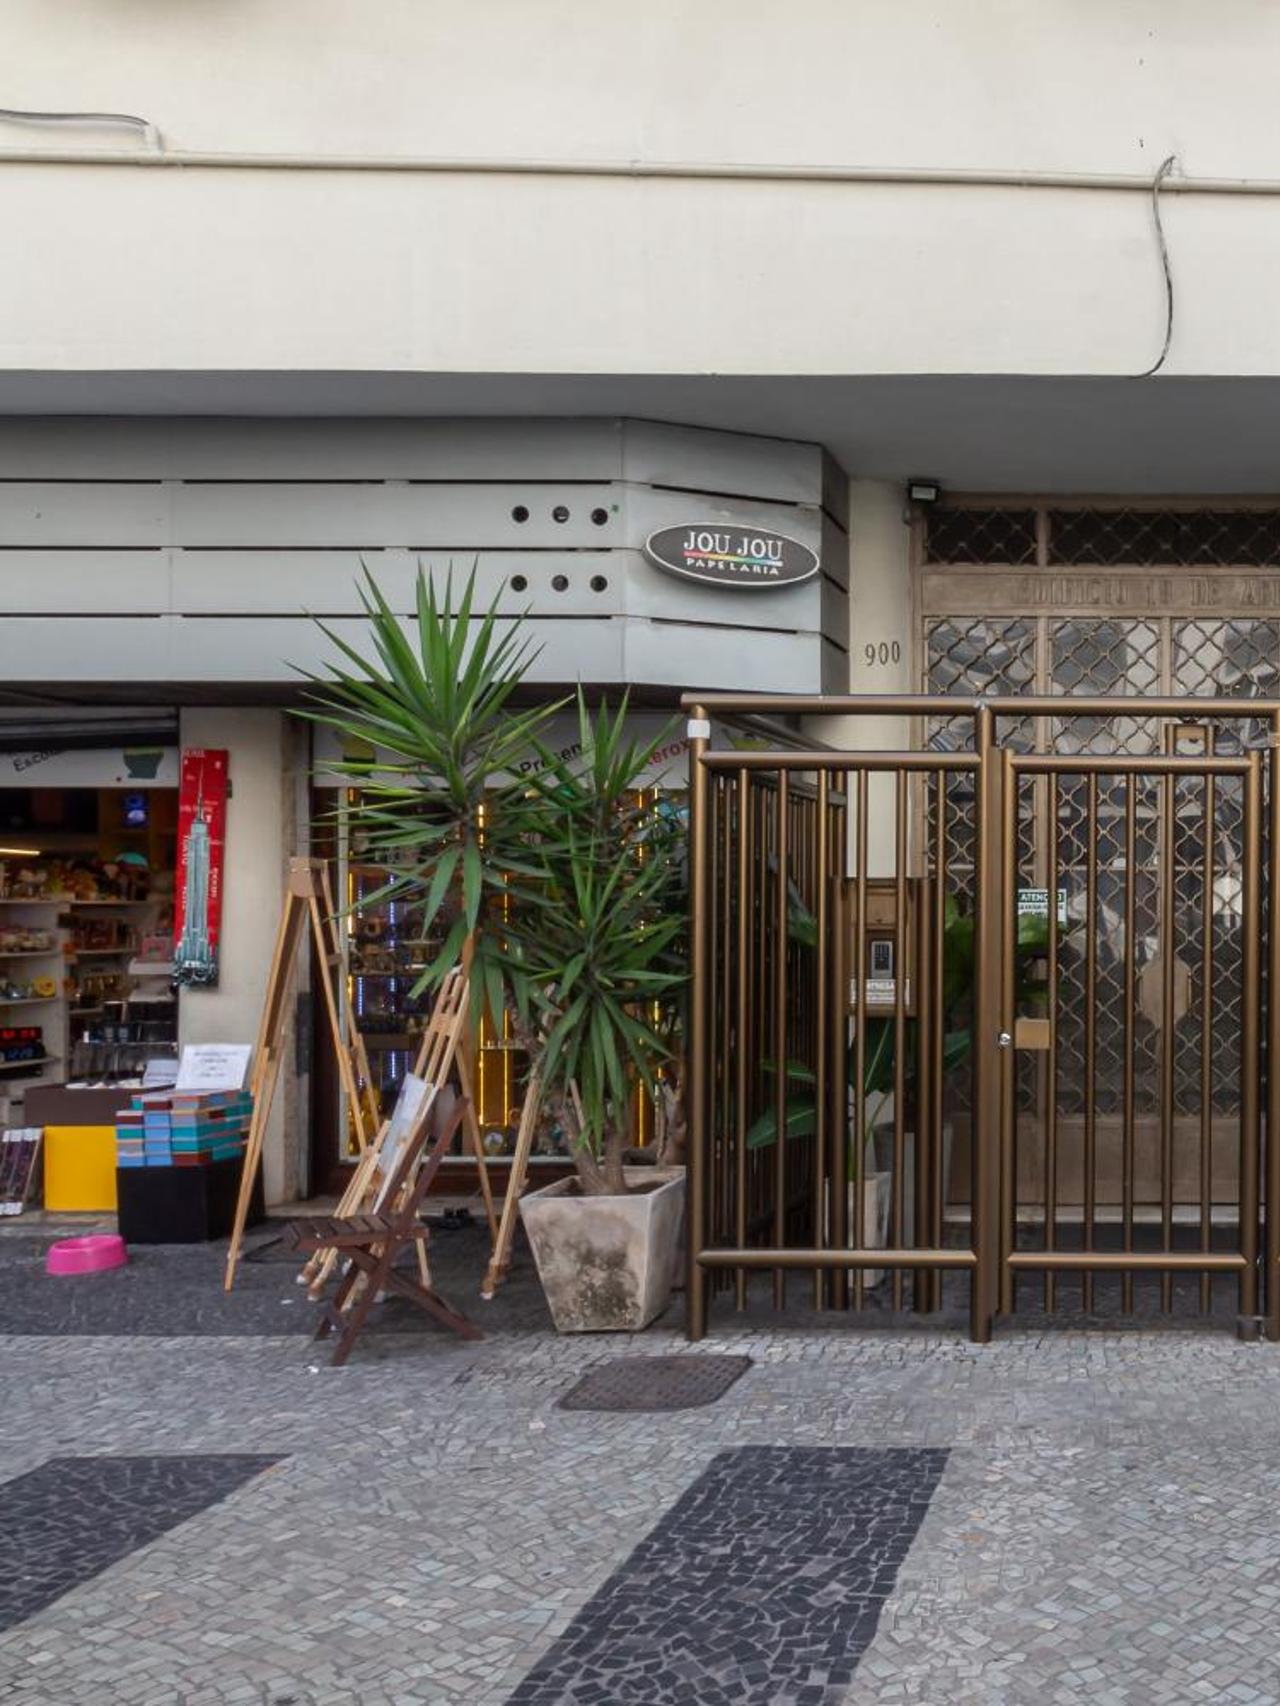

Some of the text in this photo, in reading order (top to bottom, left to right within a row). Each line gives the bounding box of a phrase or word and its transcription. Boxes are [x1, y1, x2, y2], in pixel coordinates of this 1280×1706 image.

[683, 530, 784, 560] JOU JOU
[686, 557, 779, 575] PAPELARIA
[1190, 577, 1222, 605] DE
[865, 640, 900, 666] 900
